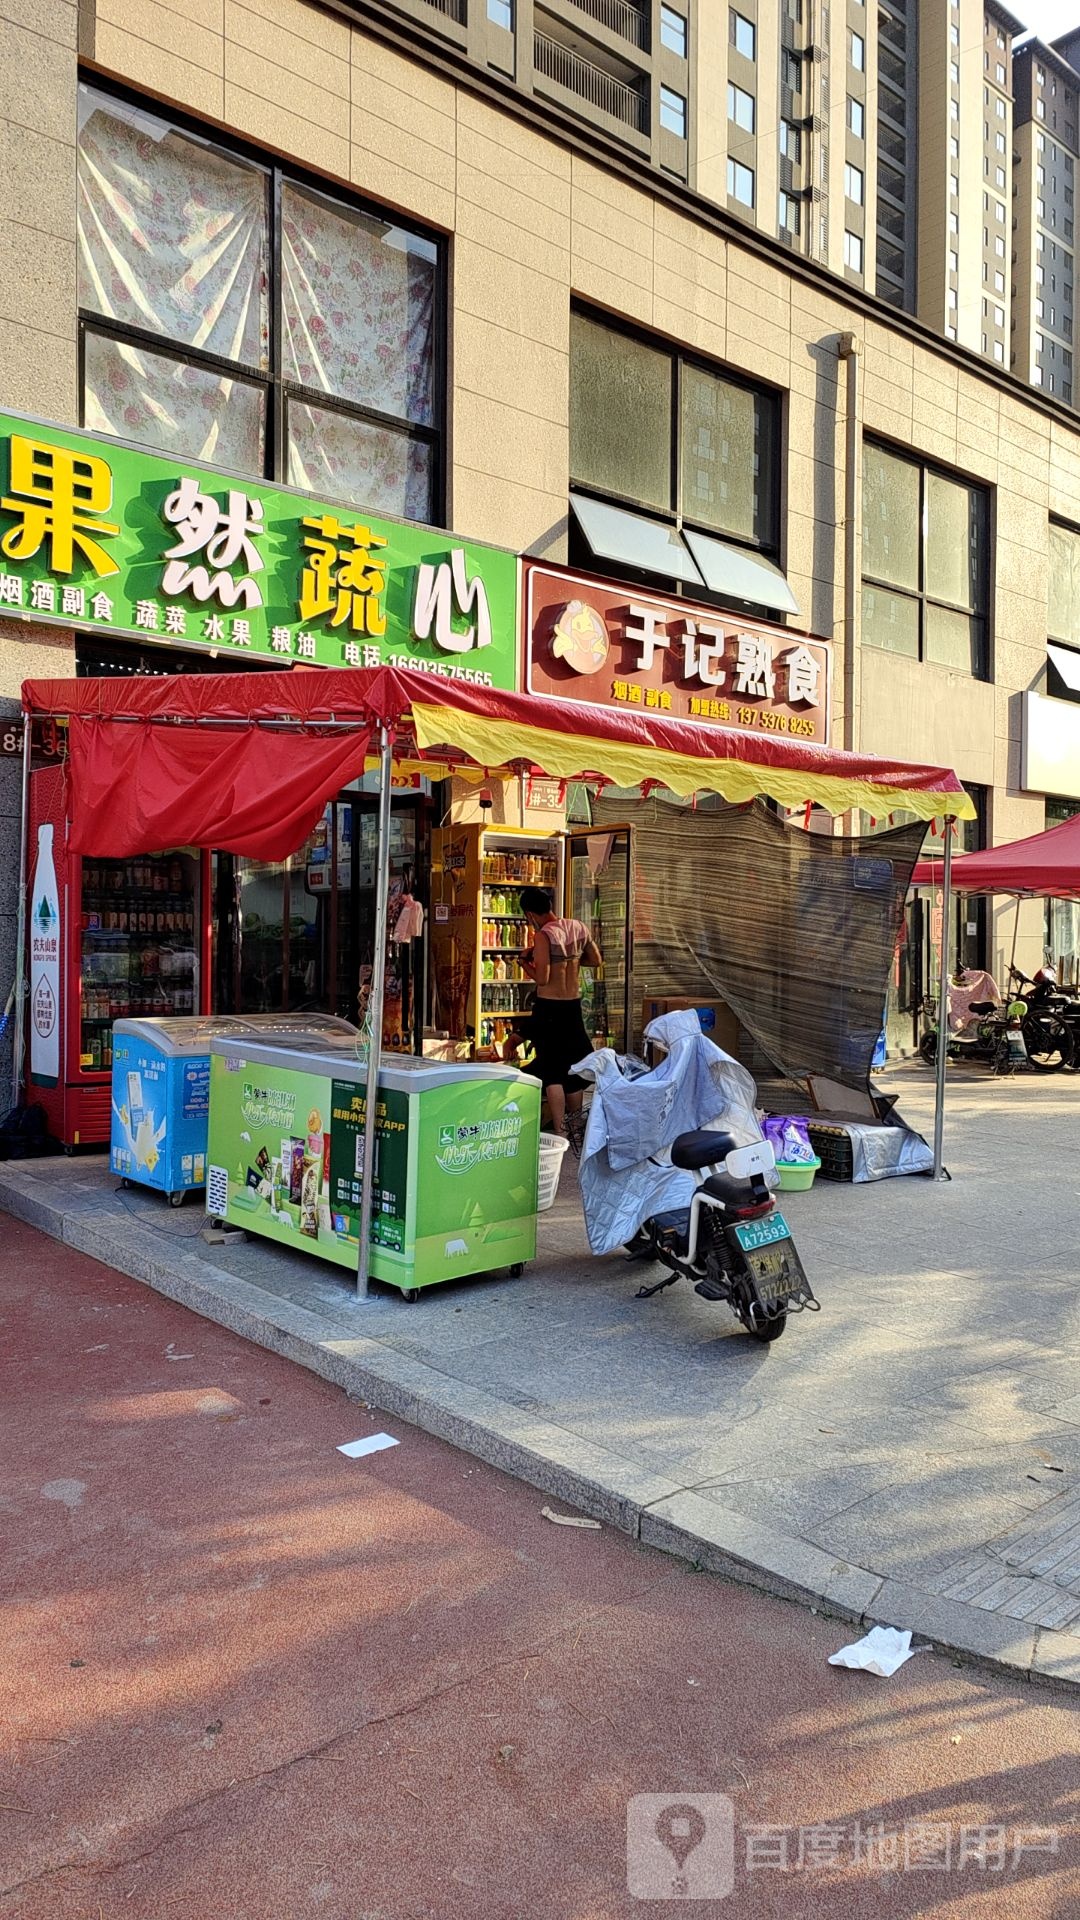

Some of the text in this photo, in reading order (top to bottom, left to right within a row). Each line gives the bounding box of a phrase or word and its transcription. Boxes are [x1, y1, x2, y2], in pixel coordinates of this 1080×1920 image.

[0, 434, 494, 653] 果然蔬心
[0, 573, 114, 622] 烟酒副食
[135, 599, 187, 635] 蔬菜
[204, 613, 252, 646] 水果
[271, 625, 317, 659] 粮油
[623, 603, 822, 708] 于记熟食
[738, 706, 758, 726] 137
[760, 710, 787, 732] 5376
[788, 717, 816, 737] 8255
[33, 938, 57, 953] 农夫山泉
[743, 1224, 787, 1249] A72593
